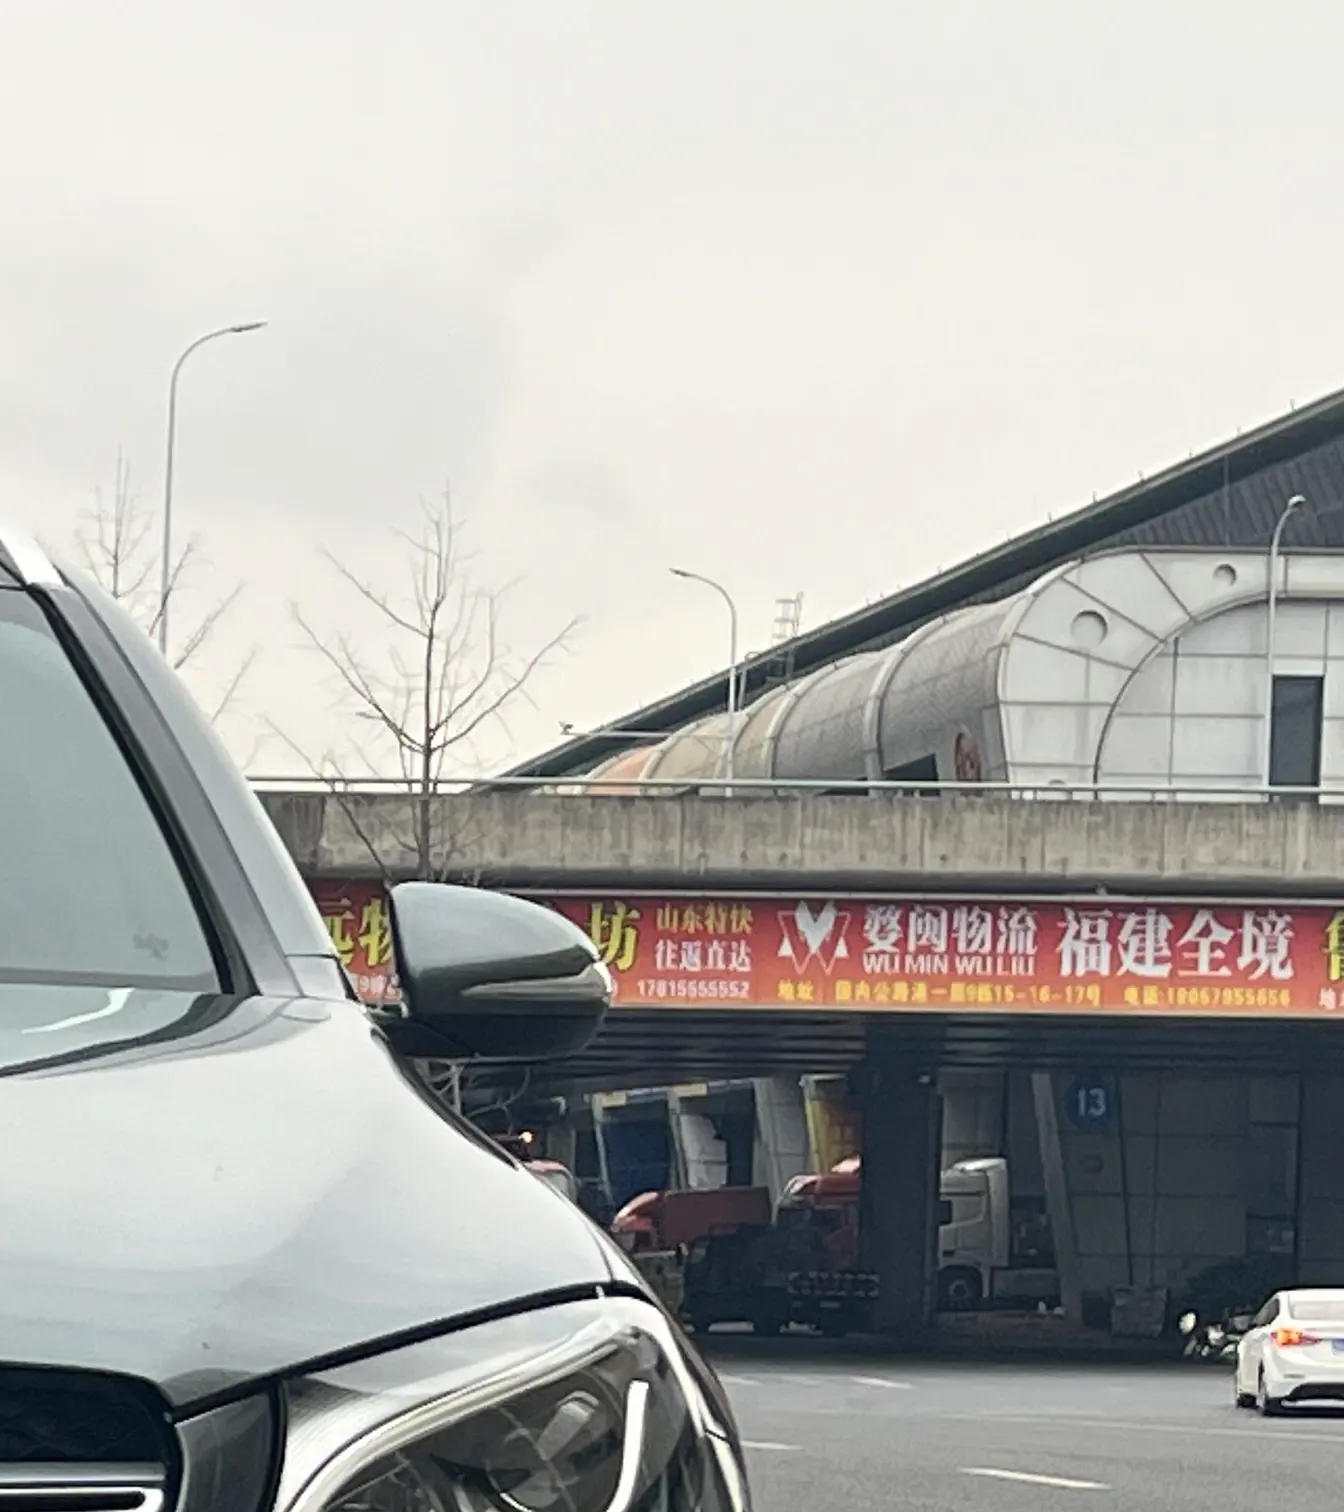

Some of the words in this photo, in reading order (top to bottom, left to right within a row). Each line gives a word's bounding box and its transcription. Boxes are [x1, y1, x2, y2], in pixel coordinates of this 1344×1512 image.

[656, 902, 754, 935] 山东特快
[655, 939, 752, 973] 往返直达
[1055, 906, 1296, 980] 福建全境
[863, 954, 900, 975] WU
[905, 954, 949, 976] MIN
[954, 954, 992, 976] WU
[996, 955, 1035, 977] LIU
[1077, 1087, 1106, 1117] 13
